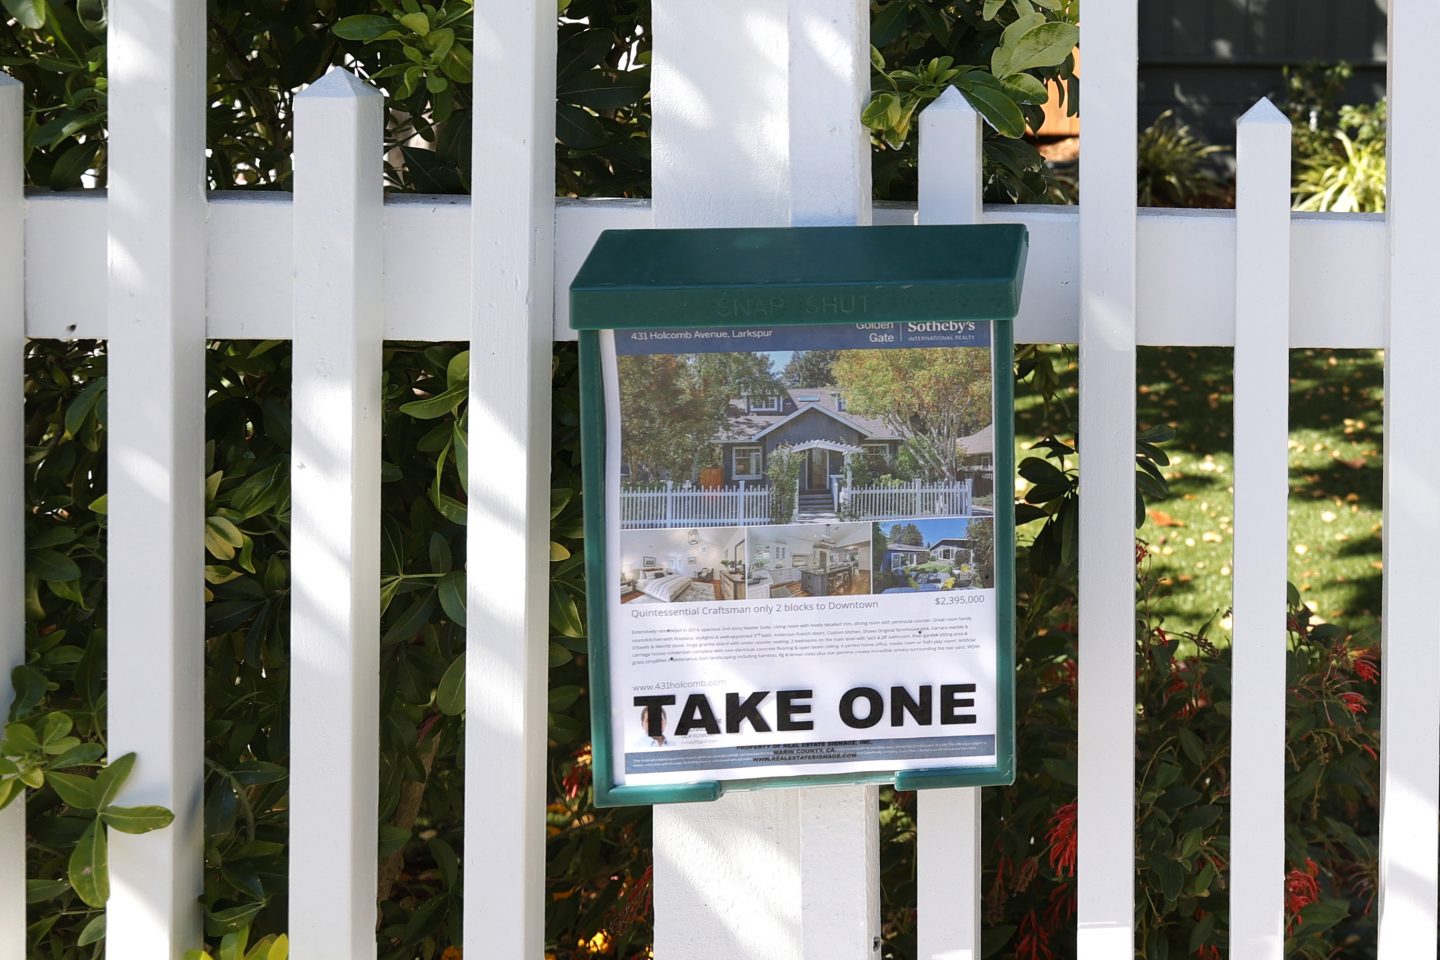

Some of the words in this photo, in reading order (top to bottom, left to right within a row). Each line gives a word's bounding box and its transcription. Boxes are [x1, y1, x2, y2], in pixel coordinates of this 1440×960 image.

[717, 296, 784, 317] SNAP
[806, 294, 871, 314] SHUT
[856, 321, 894, 330] Golden
[907, 321, 976, 334] Sotheby's
[631, 332, 648, 341] 431
[650, 331, 692, 340] Holcomb
[732, 329, 773, 339] Larkspur
[869, 332, 894, 343] Gate
[935, 595, 985, 606] $2,395,000
[631, 608, 700, 618] Quintessential
[702, 606, 751, 616] Craftsman
[753, 604, 773, 615] only
[776, 604, 782, 612] 2
[784, 602, 815, 612] blocks
[816, 602, 826, 610] to
[829, 600, 879, 610] Downtown
[632, 679, 727, 692] www.431holcomb.com
[633, 690, 814, 736] TAKE
[839, 683, 977, 730] ONE
